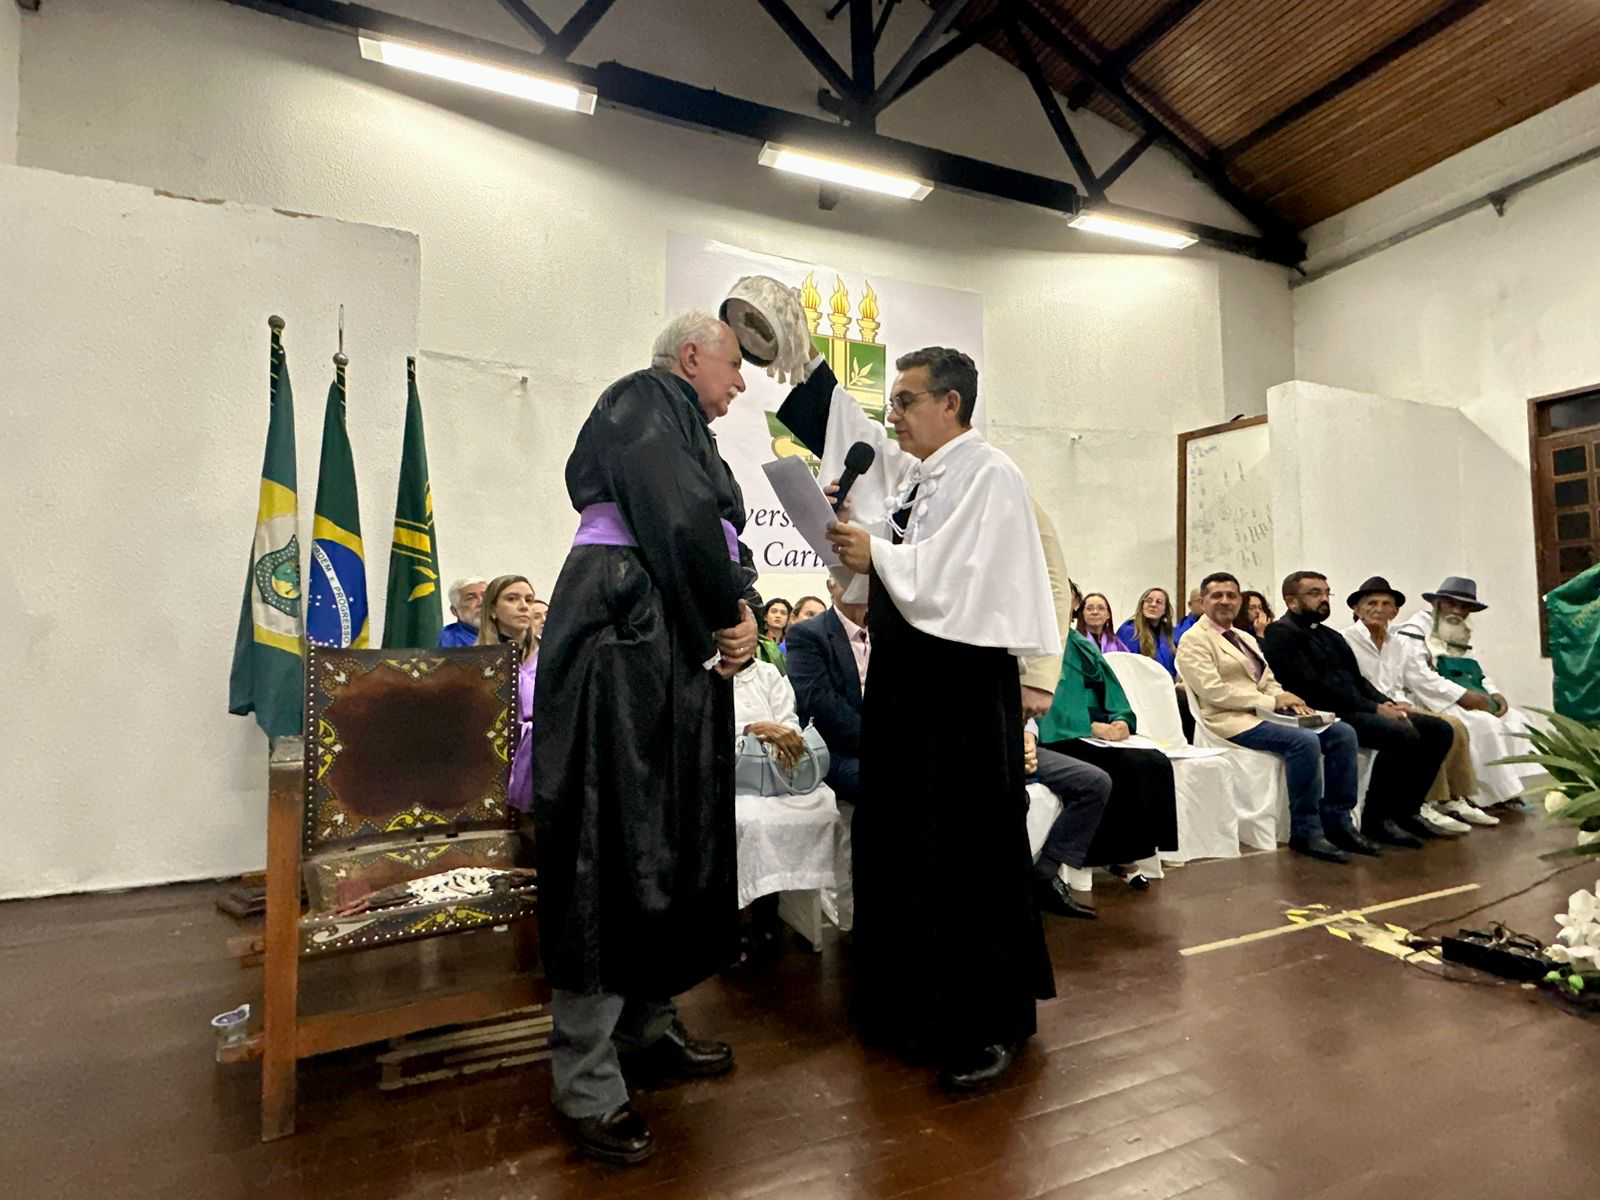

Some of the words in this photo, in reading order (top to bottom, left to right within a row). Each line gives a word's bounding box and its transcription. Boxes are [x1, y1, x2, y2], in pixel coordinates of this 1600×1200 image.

[763, 541, 825, 567] Cari
[312, 543, 332, 572] ORDEM
[334, 586, 350, 644] PROGRESSO
